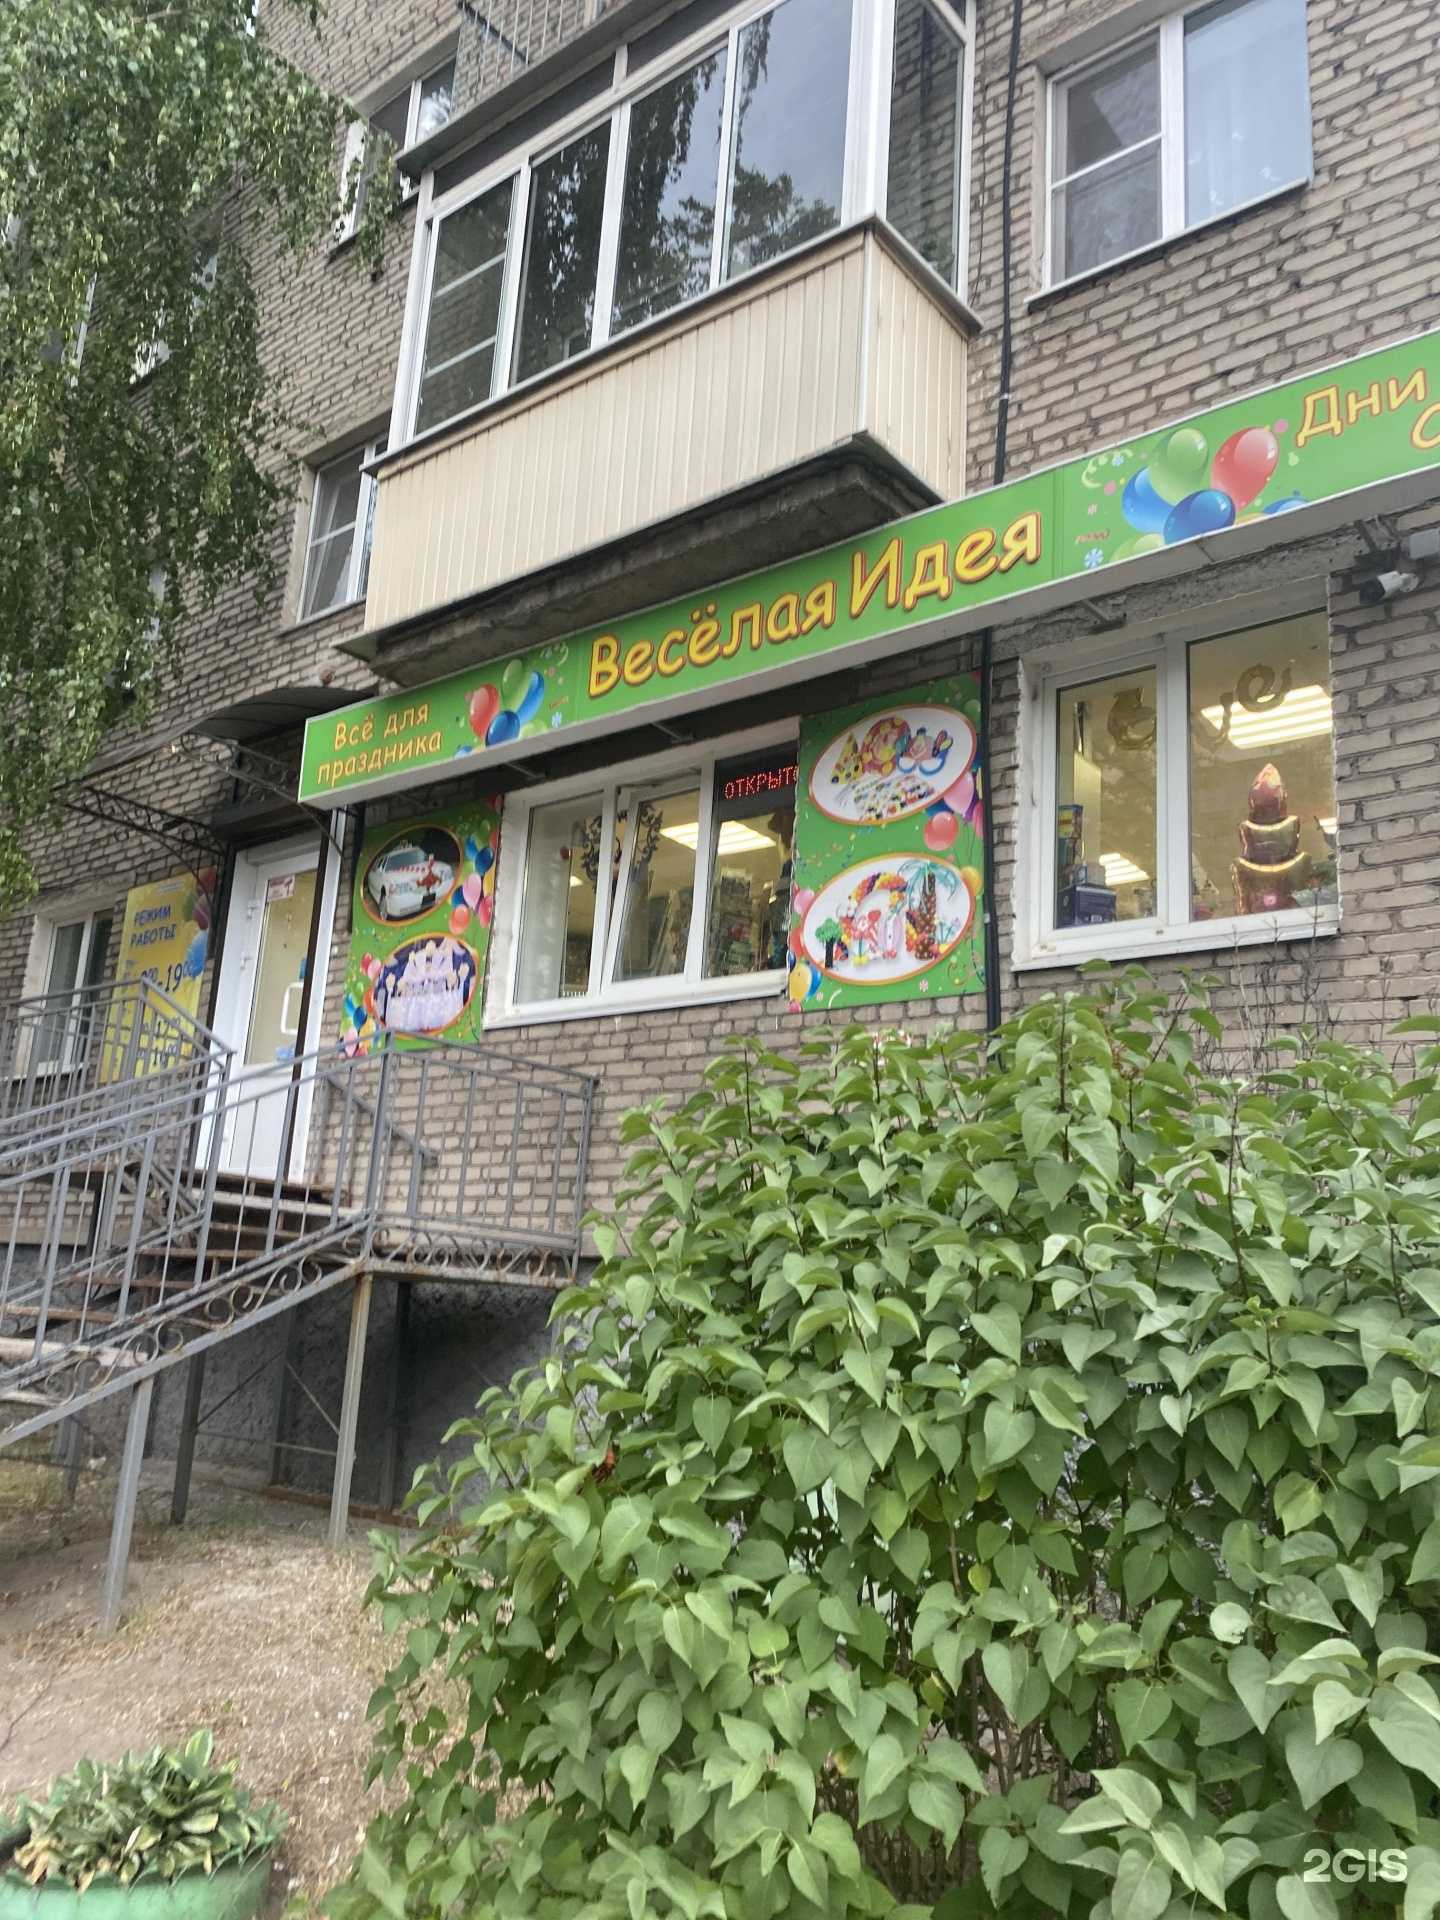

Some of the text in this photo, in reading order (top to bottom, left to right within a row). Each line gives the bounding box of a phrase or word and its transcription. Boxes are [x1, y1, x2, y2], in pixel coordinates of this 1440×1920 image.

[1296, 367, 1427, 448] Дни
[587, 510, 1042, 699] Весёлая Идея
[334, 703, 430, 751] Всё для
[316, 730, 443, 786] праздника
[130, 923, 177, 948] РАБОТЫ
[134, 904, 171, 927] РЕЖИМ
